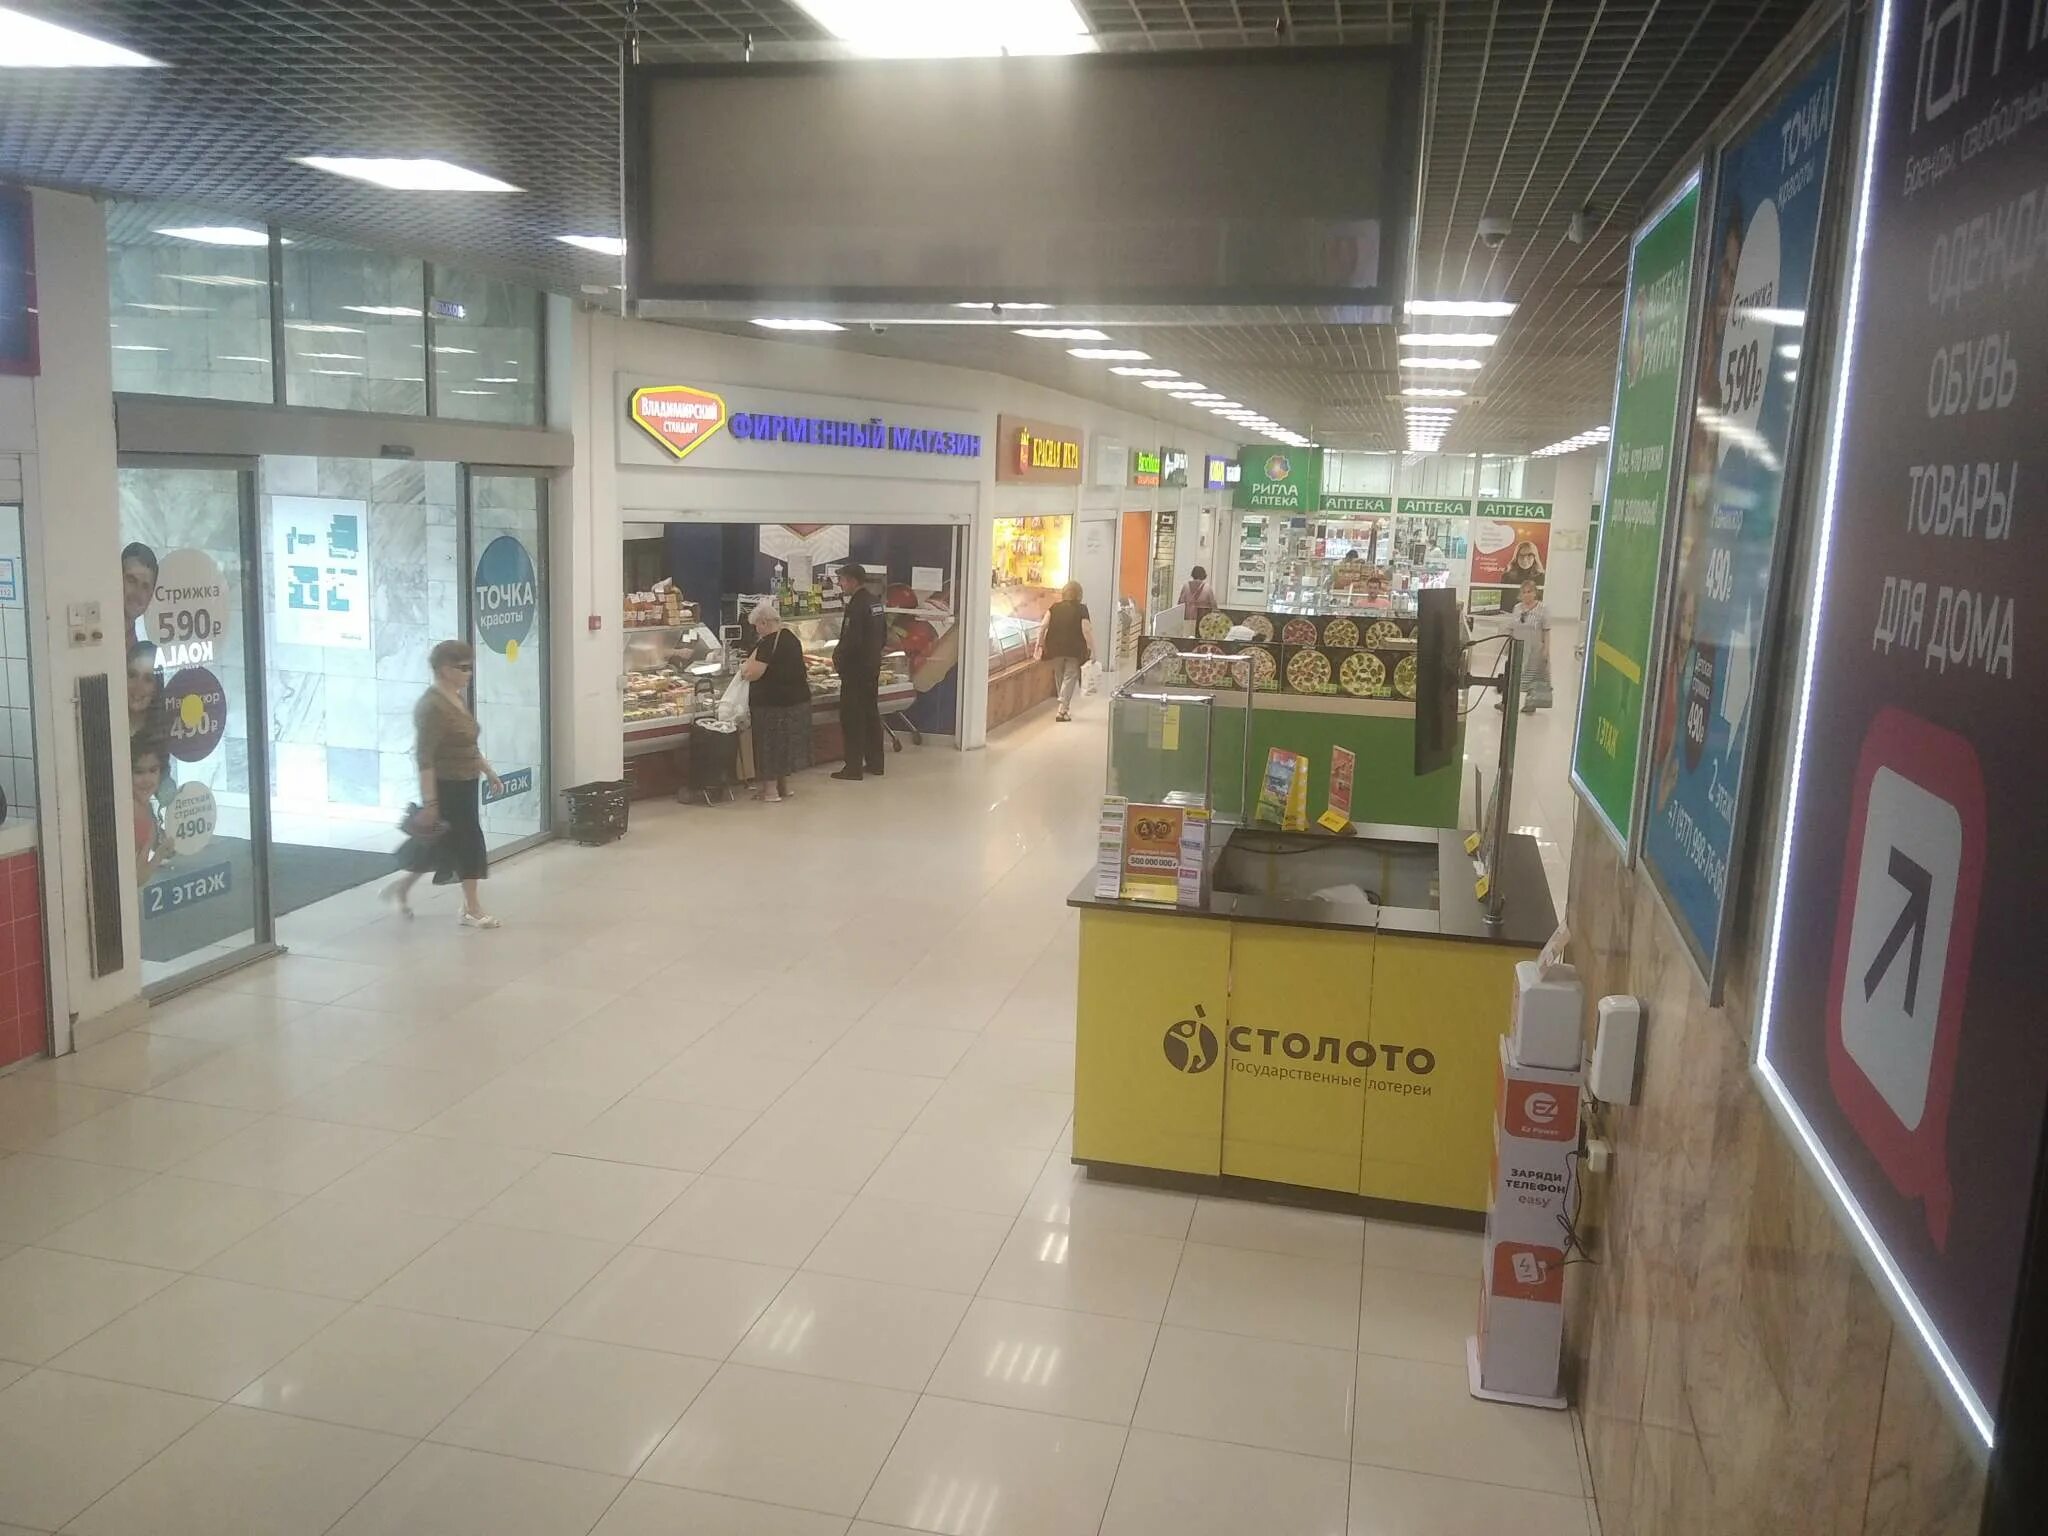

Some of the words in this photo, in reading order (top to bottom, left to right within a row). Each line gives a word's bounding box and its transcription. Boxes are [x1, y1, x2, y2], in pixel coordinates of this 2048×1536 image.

[1781, 83, 1833, 174] ТОЧКА
[1927, 331, 2018, 419] ОБУВЬ
[729, 413, 887, 449] ФИРМЕННЫЙ
[889, 426, 982, 457] МАГАЗИН
[1251, 495, 1299, 506] АПТЕКА
[1252, 483, 1299, 496] РИГЛА
[1907, 461, 2019, 540] ТОВАРЫ
[1326, 498, 1385, 510] АПТЕКА
[1404, 500, 1465, 514] АПТЕКА
[1484, 503, 1545, 517] АПТЕКА
[154, 585, 221, 604] Стрижка
[476, 581, 535, 610] ТОЧКА
[480, 610, 524, 630] красоты
[1872, 575, 1927, 656] ДЛЯ
[1925, 585, 2017, 680] ДОМА
[1708, 758, 1719, 804] 2
[150, 887, 164, 913] 2
[172, 870, 226, 905] этаж
[1229, 1026, 1435, 1075] СТОЛОТО
[1230, 1058, 1362, 1087] Государственные
[1367, 1078, 1433, 1097] лотереи
[1506, 1179, 1566, 1194] ТЕЛЕФОН
[1511, 1168, 1563, 1182] ЗАРЯДИ
[1518, 1195, 1551, 1209] easy
